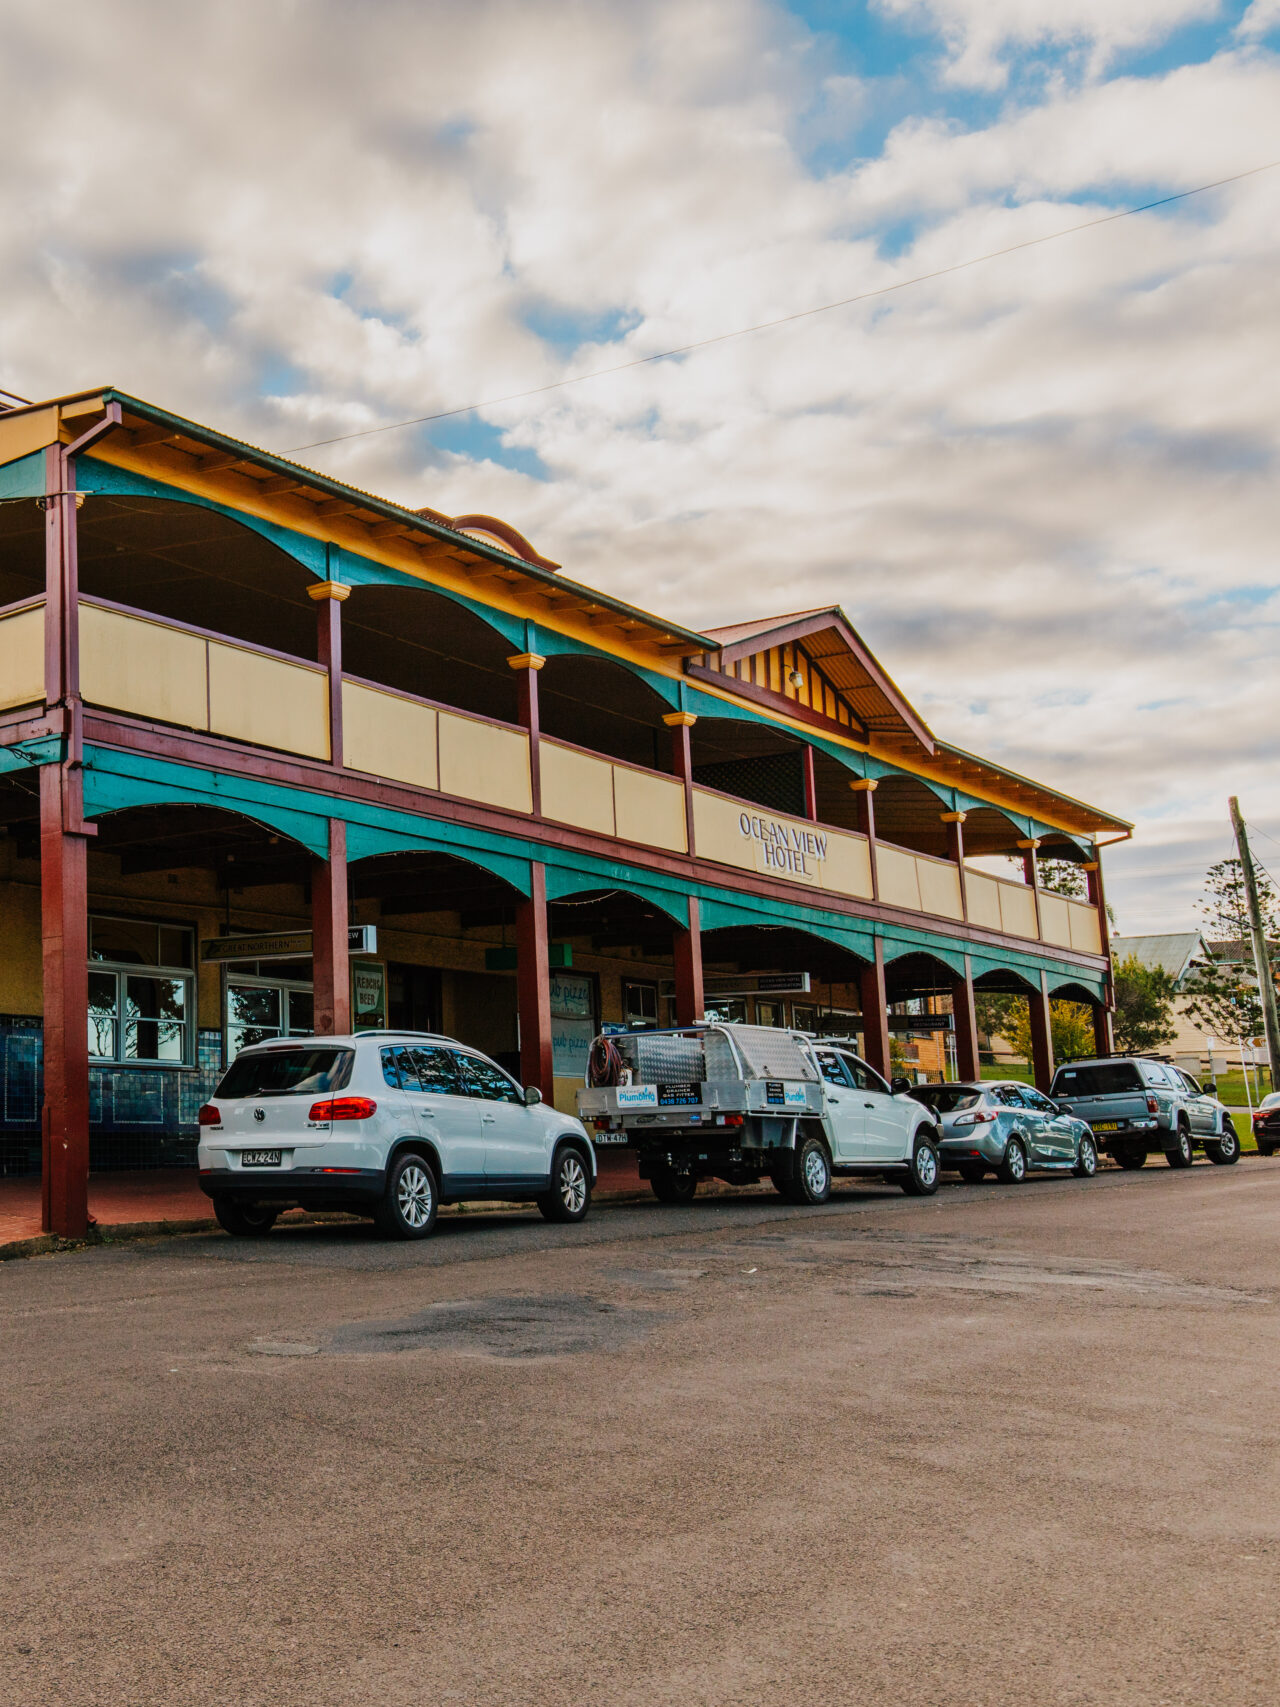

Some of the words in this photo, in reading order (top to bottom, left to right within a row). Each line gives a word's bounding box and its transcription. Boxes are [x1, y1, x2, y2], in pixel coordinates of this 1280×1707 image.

[739, 812, 790, 849] OCEAN
[792, 828, 828, 859] VIEW
[764, 842, 813, 877] HOTEL
[221, 943, 245, 953] GREAT
[248, 940, 290, 951] NORTHERN
[360, 992, 376, 1006] BEER
[619, 1092, 655, 1102] Plumbing
